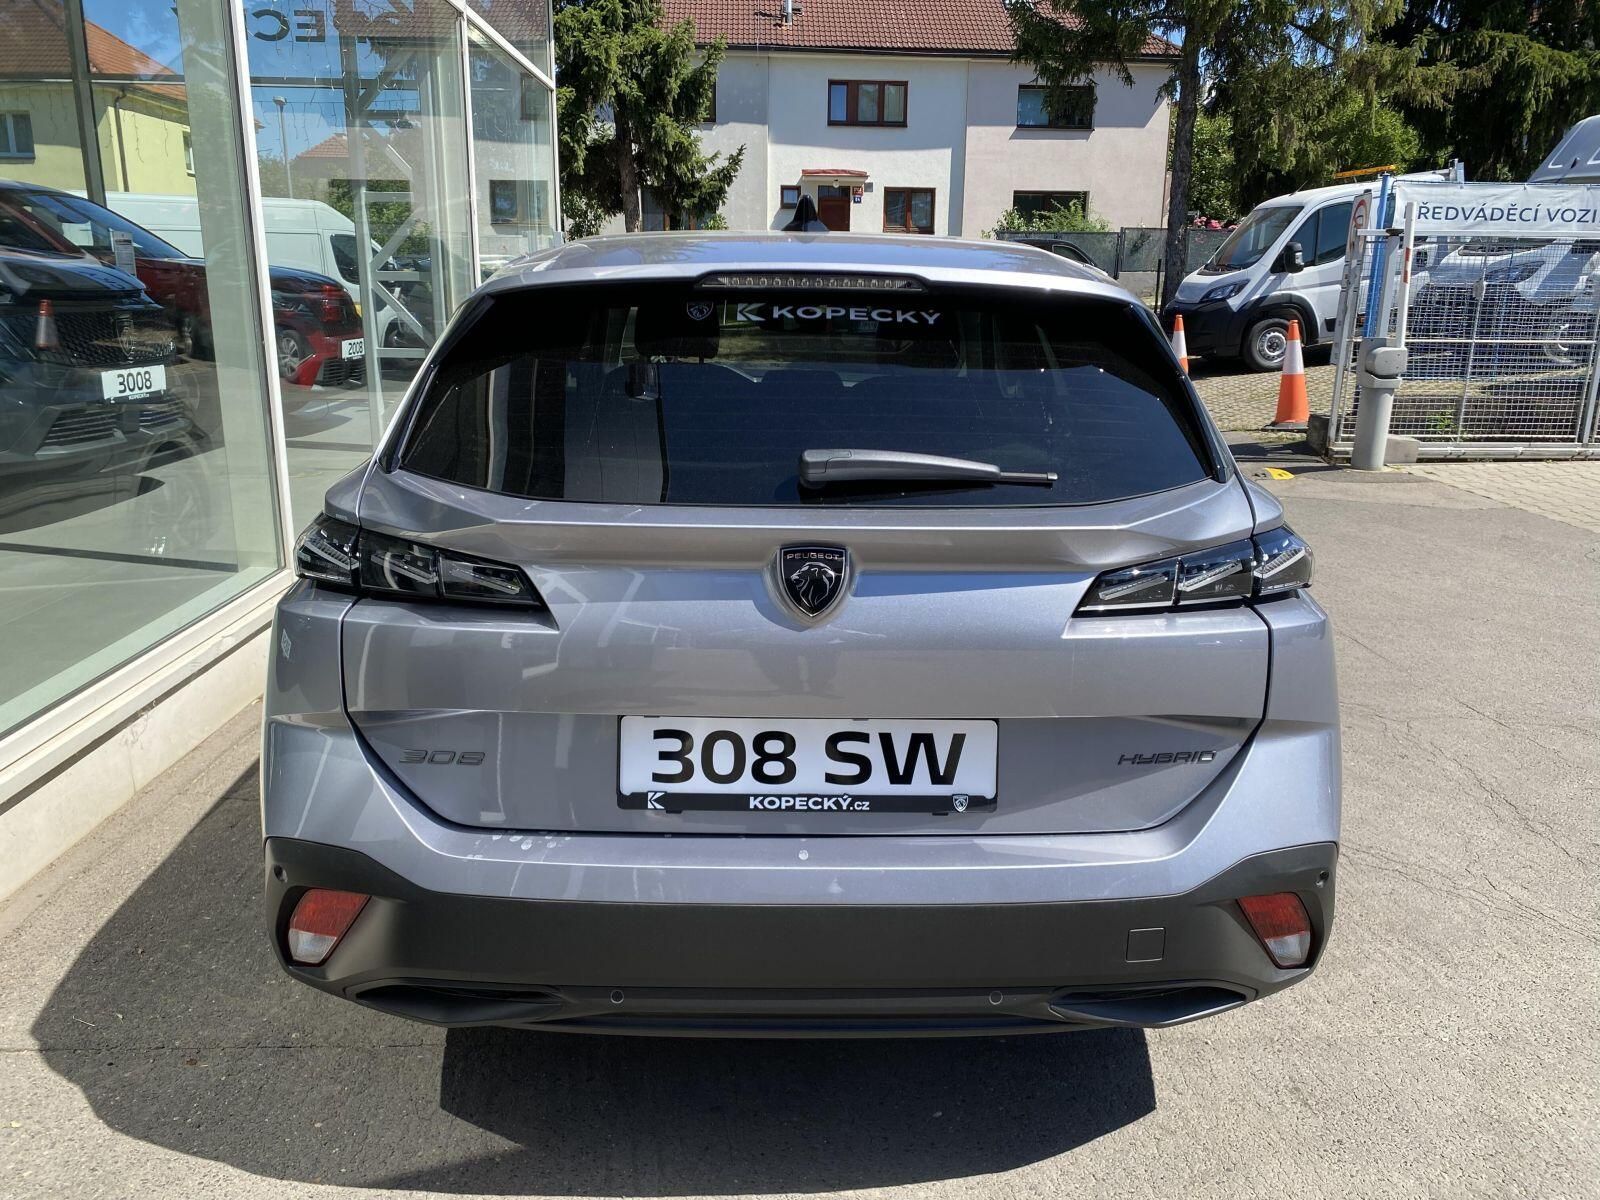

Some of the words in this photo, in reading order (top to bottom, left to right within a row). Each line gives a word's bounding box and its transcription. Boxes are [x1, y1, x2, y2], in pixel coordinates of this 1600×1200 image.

[1404, 202, 1541, 222] ŘEDVÁDĚCÍ
[1546, 208, 1600, 223] VOZI
[773, 305, 941, 325] KOPECKÝ
[348, 341, 364, 355] 2008
[117, 371, 152, 394] 3008
[786, 552, 841, 560] PEUGEOT
[399, 749, 485, 765] 308
[651, 729, 797, 785] 308
[824, 731, 967, 786] SW
[1117, 750, 1217, 765] HYBRID
[749, 794, 870, 811] KOPECKÝ.cz
